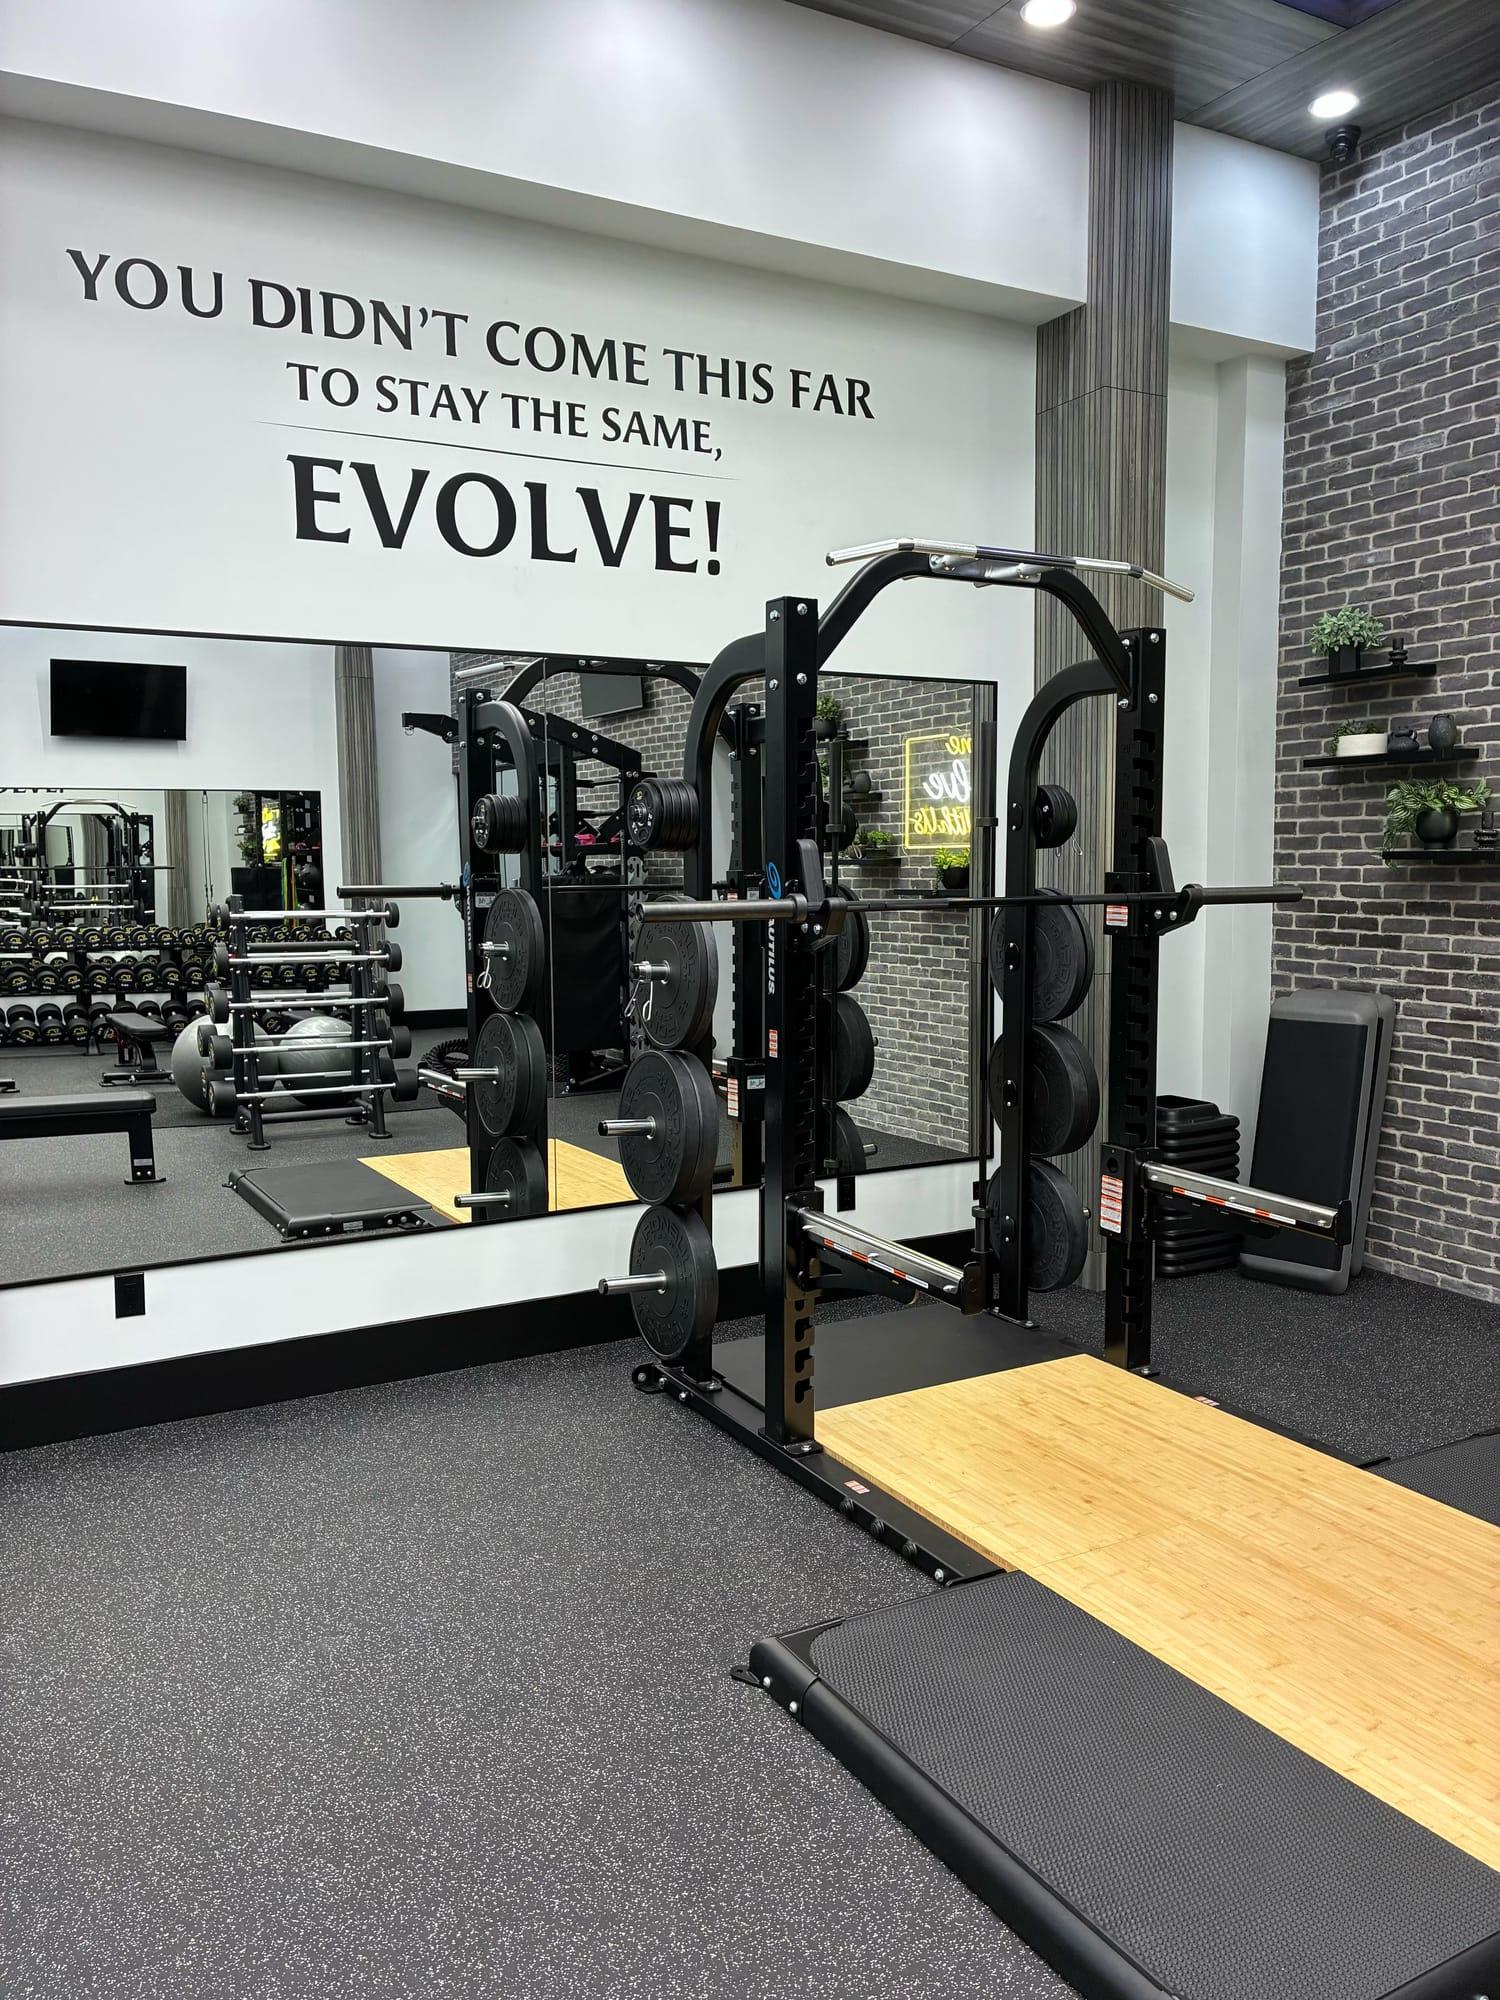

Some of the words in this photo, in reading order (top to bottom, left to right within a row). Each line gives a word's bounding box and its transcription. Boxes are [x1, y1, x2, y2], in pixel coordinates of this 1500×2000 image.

[66, 249, 223, 319] YOU
[248, 279, 469, 357] DIDN'T
[486, 320, 650, 386] COME
[662, 348, 774, 405] THIS
[790, 368, 875, 420] FAR
[286, 361, 359, 407] TO
[375, 375, 489, 424] STAY
[500, 392, 589, 438] THE
[602, 407, 722, 462] SAME,
[286, 454, 721, 576] EVOLVE!
[767, 898, 776, 994] AUTILUS
